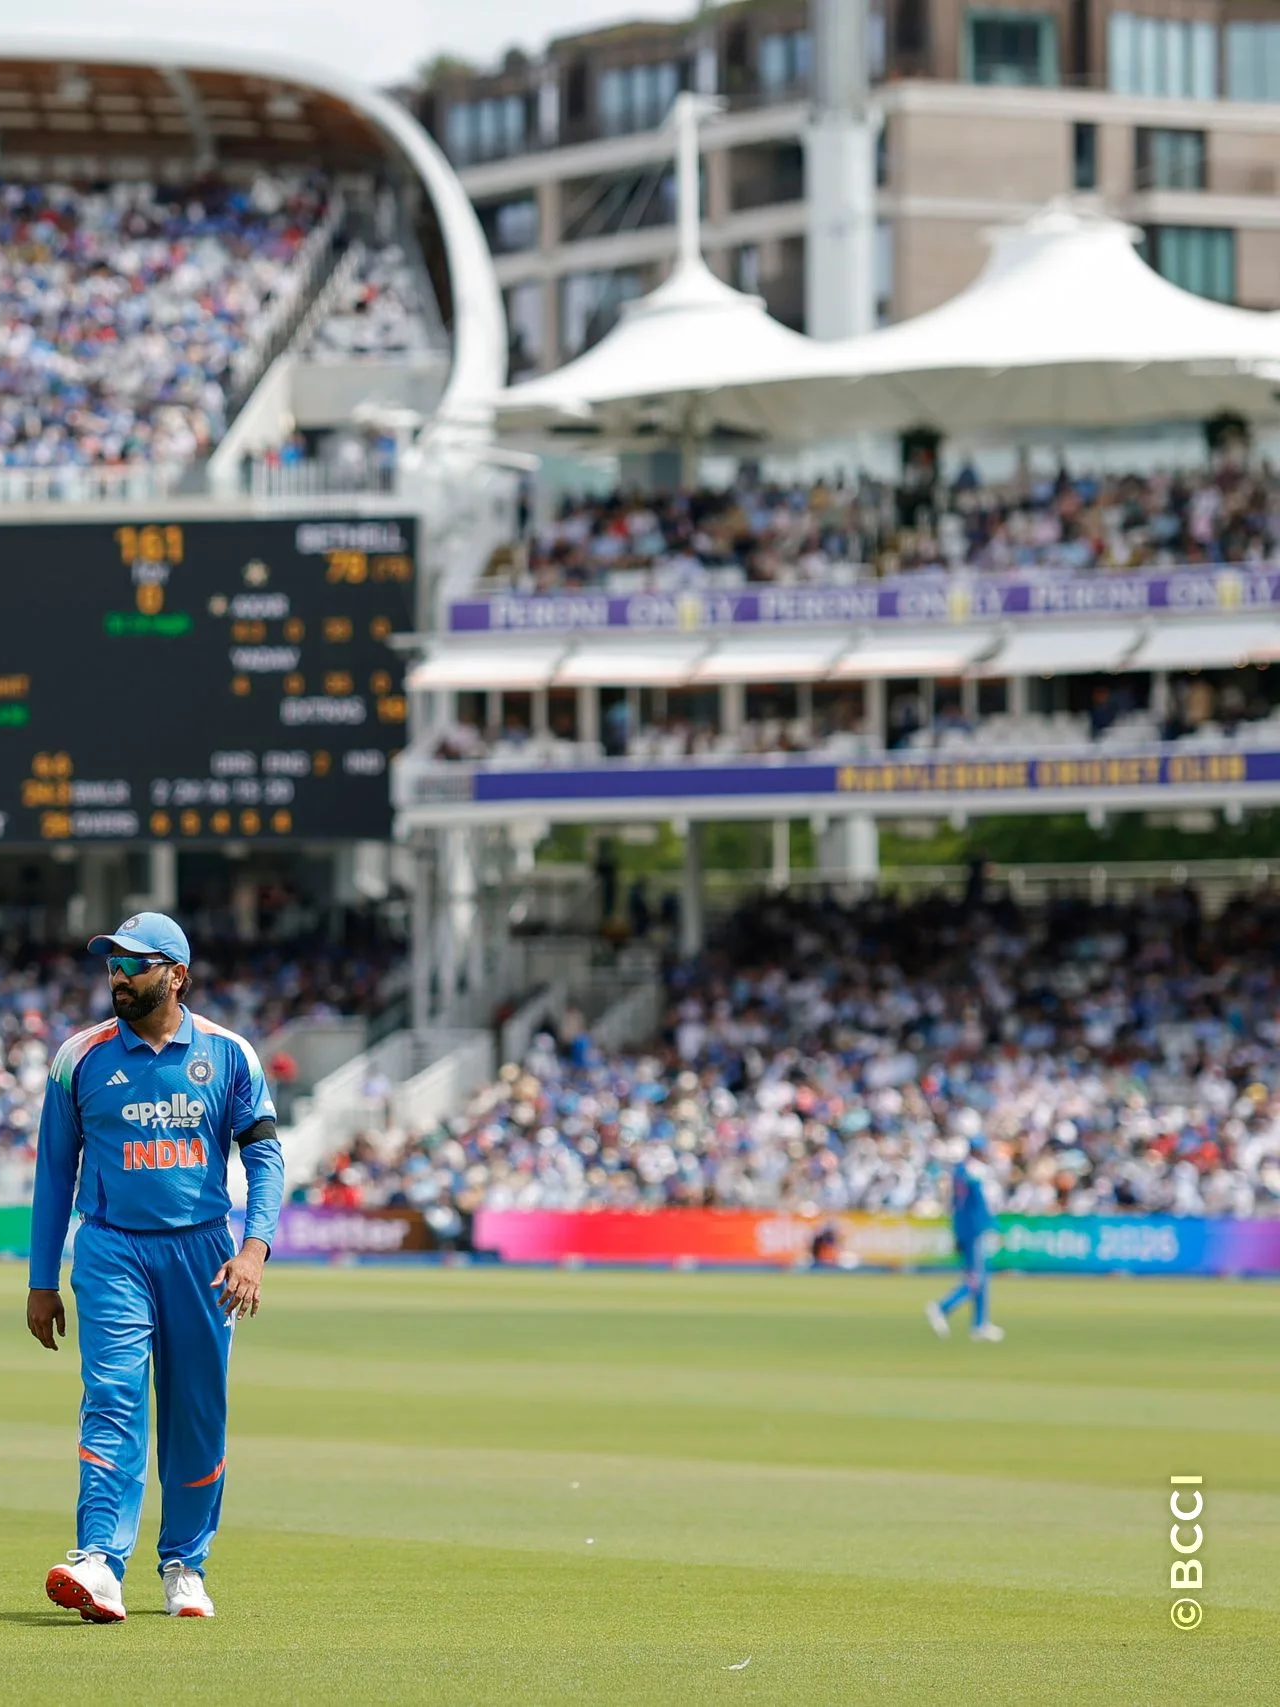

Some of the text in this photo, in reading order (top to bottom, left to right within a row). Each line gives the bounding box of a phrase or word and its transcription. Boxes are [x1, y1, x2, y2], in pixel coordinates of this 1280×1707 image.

[114, 526, 181, 564] 161
[324, 549, 366, 581] 78
[491, 597, 606, 632] PERONI
[761, 591, 877, 624] PERONI
[1032, 580, 1147, 614] PERONI
[1037, 756, 1159, 789] CRICKET
[1170, 752, 1244, 785] CLUB
[122, 1092, 205, 1126] apollo
[151, 1116, 202, 1129] TYRES
[123, 1138, 208, 1171] INDIA
